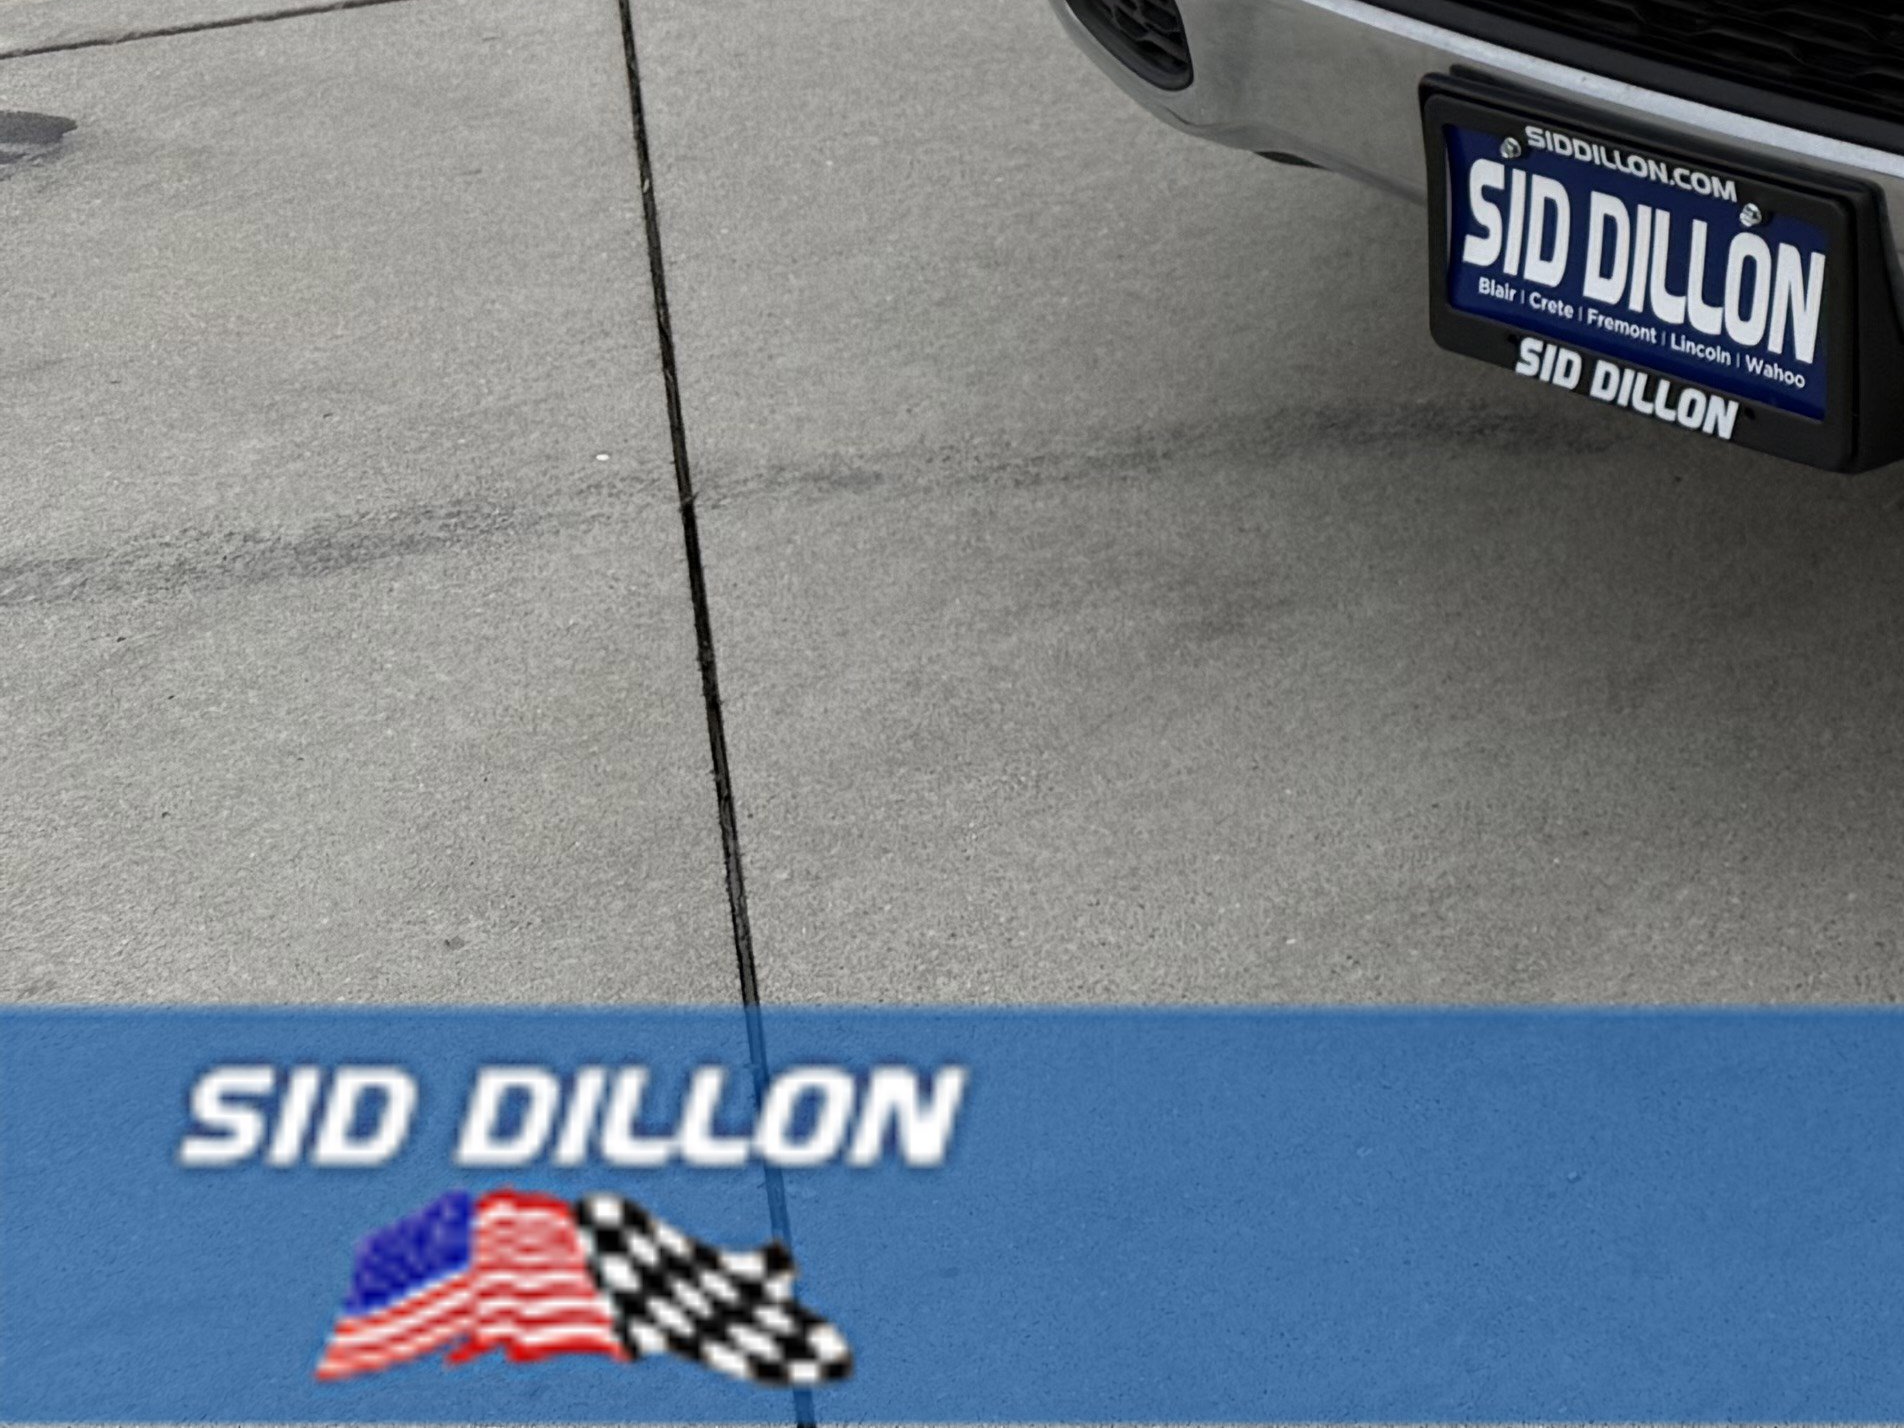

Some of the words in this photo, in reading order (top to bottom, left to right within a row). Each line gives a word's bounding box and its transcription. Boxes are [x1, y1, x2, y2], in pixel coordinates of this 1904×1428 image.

[1524, 124, 1738, 203] SIDDILLON.COM
[1462, 157, 1571, 288] SID
[1582, 190, 1827, 364] DILLON
[1478, 276, 1517, 304] Blair
[1529, 290, 1575, 321] Crete
[1586, 307, 1658, 345] Fremont
[1669, 332, 1733, 367] Lincoln
[1744, 353, 1807, 390] Wahoo
[1514, 336, 1583, 392] SID
[1588, 358, 1741, 441] DILLON
